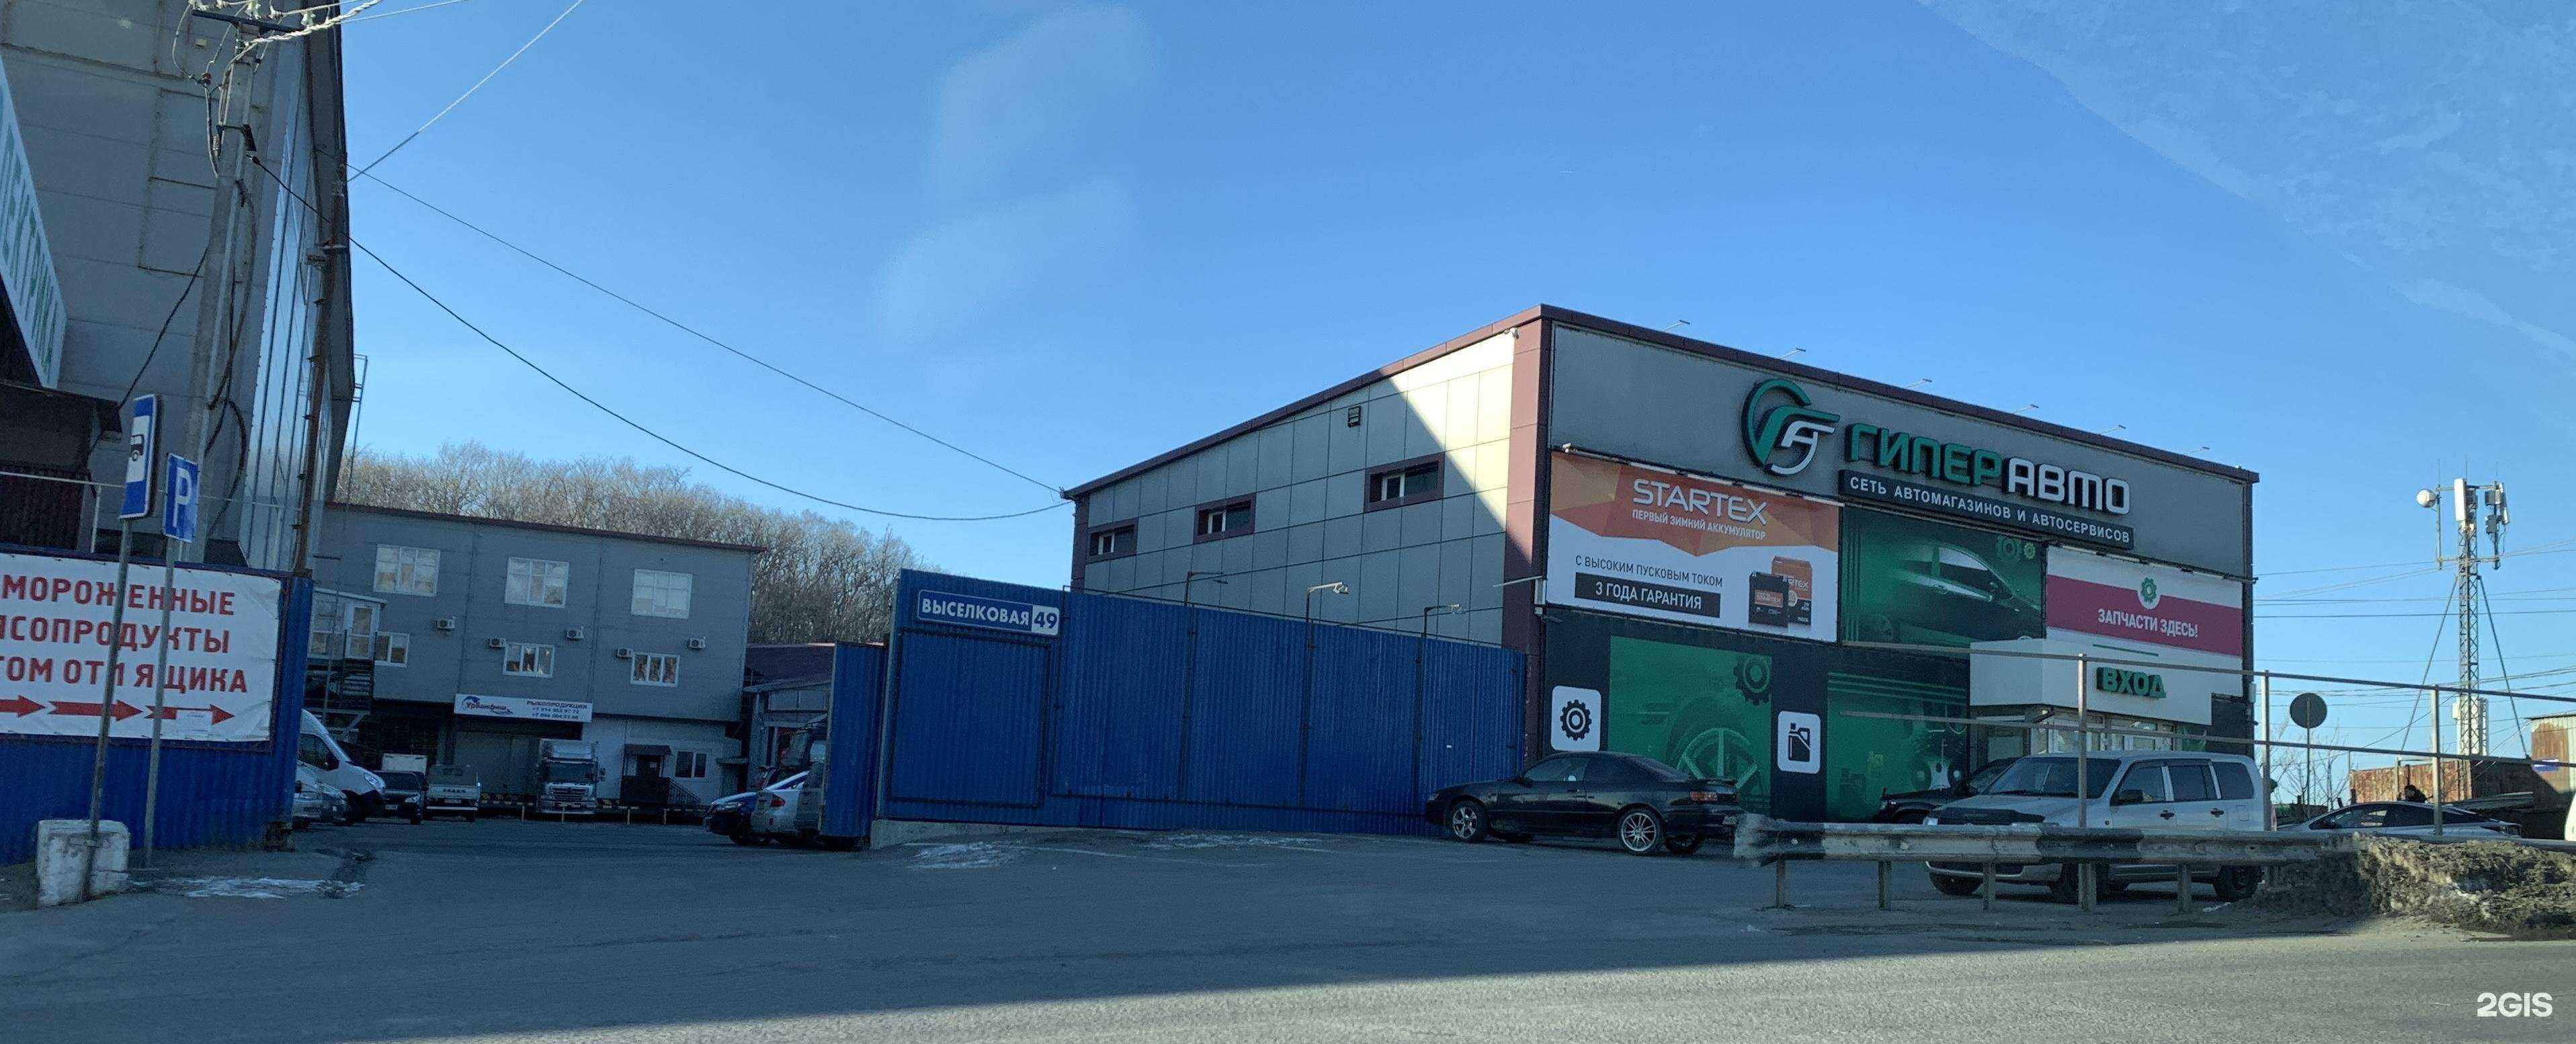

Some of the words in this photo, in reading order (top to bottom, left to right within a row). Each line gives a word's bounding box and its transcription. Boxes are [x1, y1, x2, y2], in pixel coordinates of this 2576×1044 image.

[173, 467, 192, 528] P
[1632, 478, 1768, 526] STARTEX
[1850, 476, 1886, 495] СЕТЬ
[1894, 485, 2011, 519] АВТОМАГАЗИНОВ
[2017, 510, 2026, 522] И
[2032, 513, 2130, 543] АВТОСЕРВИСОВ
[1632, 508, 1669, 524] ПЕРВЫЙ
[1669, 515, 1706, 530] ЗИМНИЙ
[1707, 521, 1767, 540] АККУМУЛЯТОР
[1575, 555, 1582, 566] С
[1584, 555, 1633, 573] ВЫСОКИМ
[1636, 564, 1690, 583] ПУСКОВЫМ
[1692, 572, 1723, 587] ТОКОМ
[1595, 581, 1602, 596] 3
[1606, 581, 1638, 602] ГОДА
[1640, 588, 1702, 610] ГАРАНТИЯ
[921, 598, 1030, 626] ВЫСЕЛКОВАЯ
[1034, 611, 1058, 629] 49
[2097, 608, 2158, 631] ЗАПЧАСТИ
[2160, 618, 2199, 638] ЗДЕСЬ!
[0, 655, 52, 683] ОМ
[63, 659, 104, 685] ОТ
[2098, 667, 2166, 699] ВХОД
